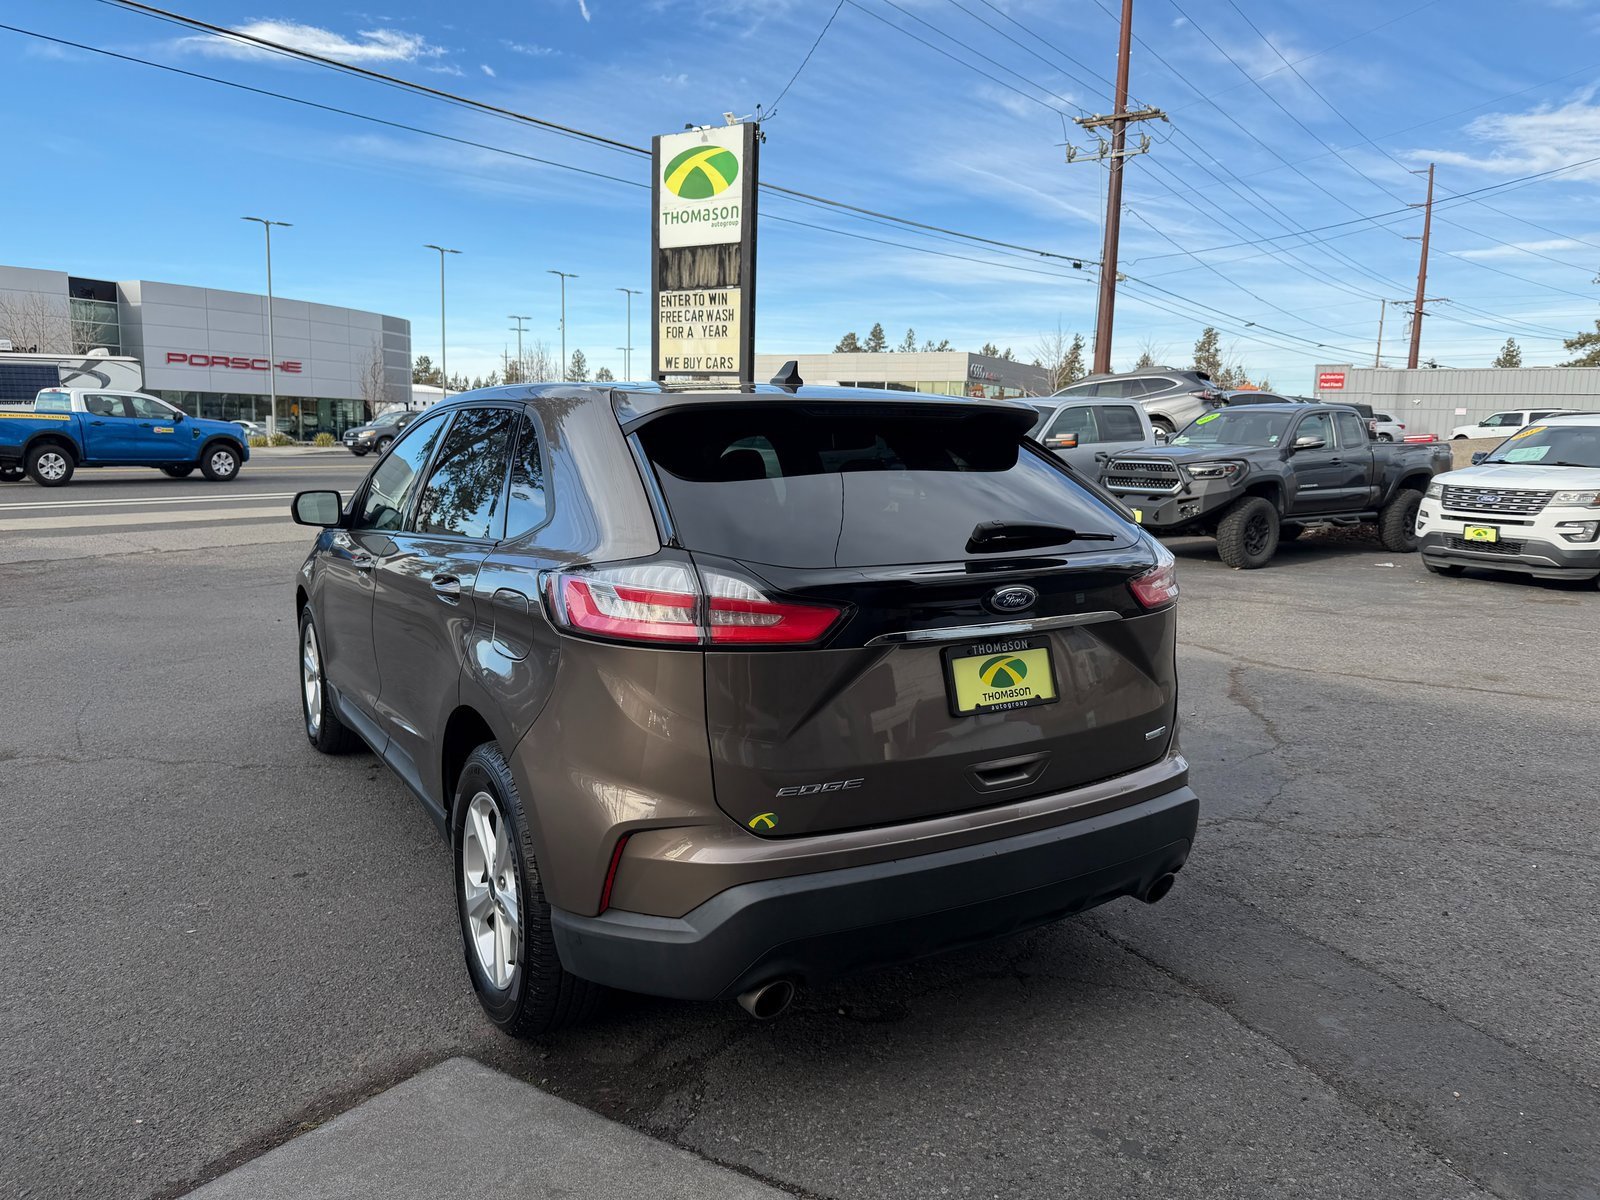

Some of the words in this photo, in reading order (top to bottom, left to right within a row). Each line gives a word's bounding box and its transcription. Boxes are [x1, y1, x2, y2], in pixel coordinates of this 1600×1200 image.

[710, 220, 739, 228] autogroup
[660, 294, 691, 307] ENTER
[692, 293, 705, 306] TO
[708, 292, 728, 306] WIN
[660, 310, 682, 323] FREE
[684, 309, 704, 322] CAR
[706, 308, 735, 322] WASH
[666, 326, 684, 339] FOR
[687, 325, 694, 338] A
[702, 324, 728, 338] YEAR
[166, 352, 303, 373] PORSCHE
[665, 356, 680, 369] WE
[683, 356, 702, 369] BUY
[705, 356, 733, 369] CARS
[1003, 592, 1027, 606] Ford
[991, 701, 1028, 711] autogroup
[775, 778, 865, 798] EDGE
